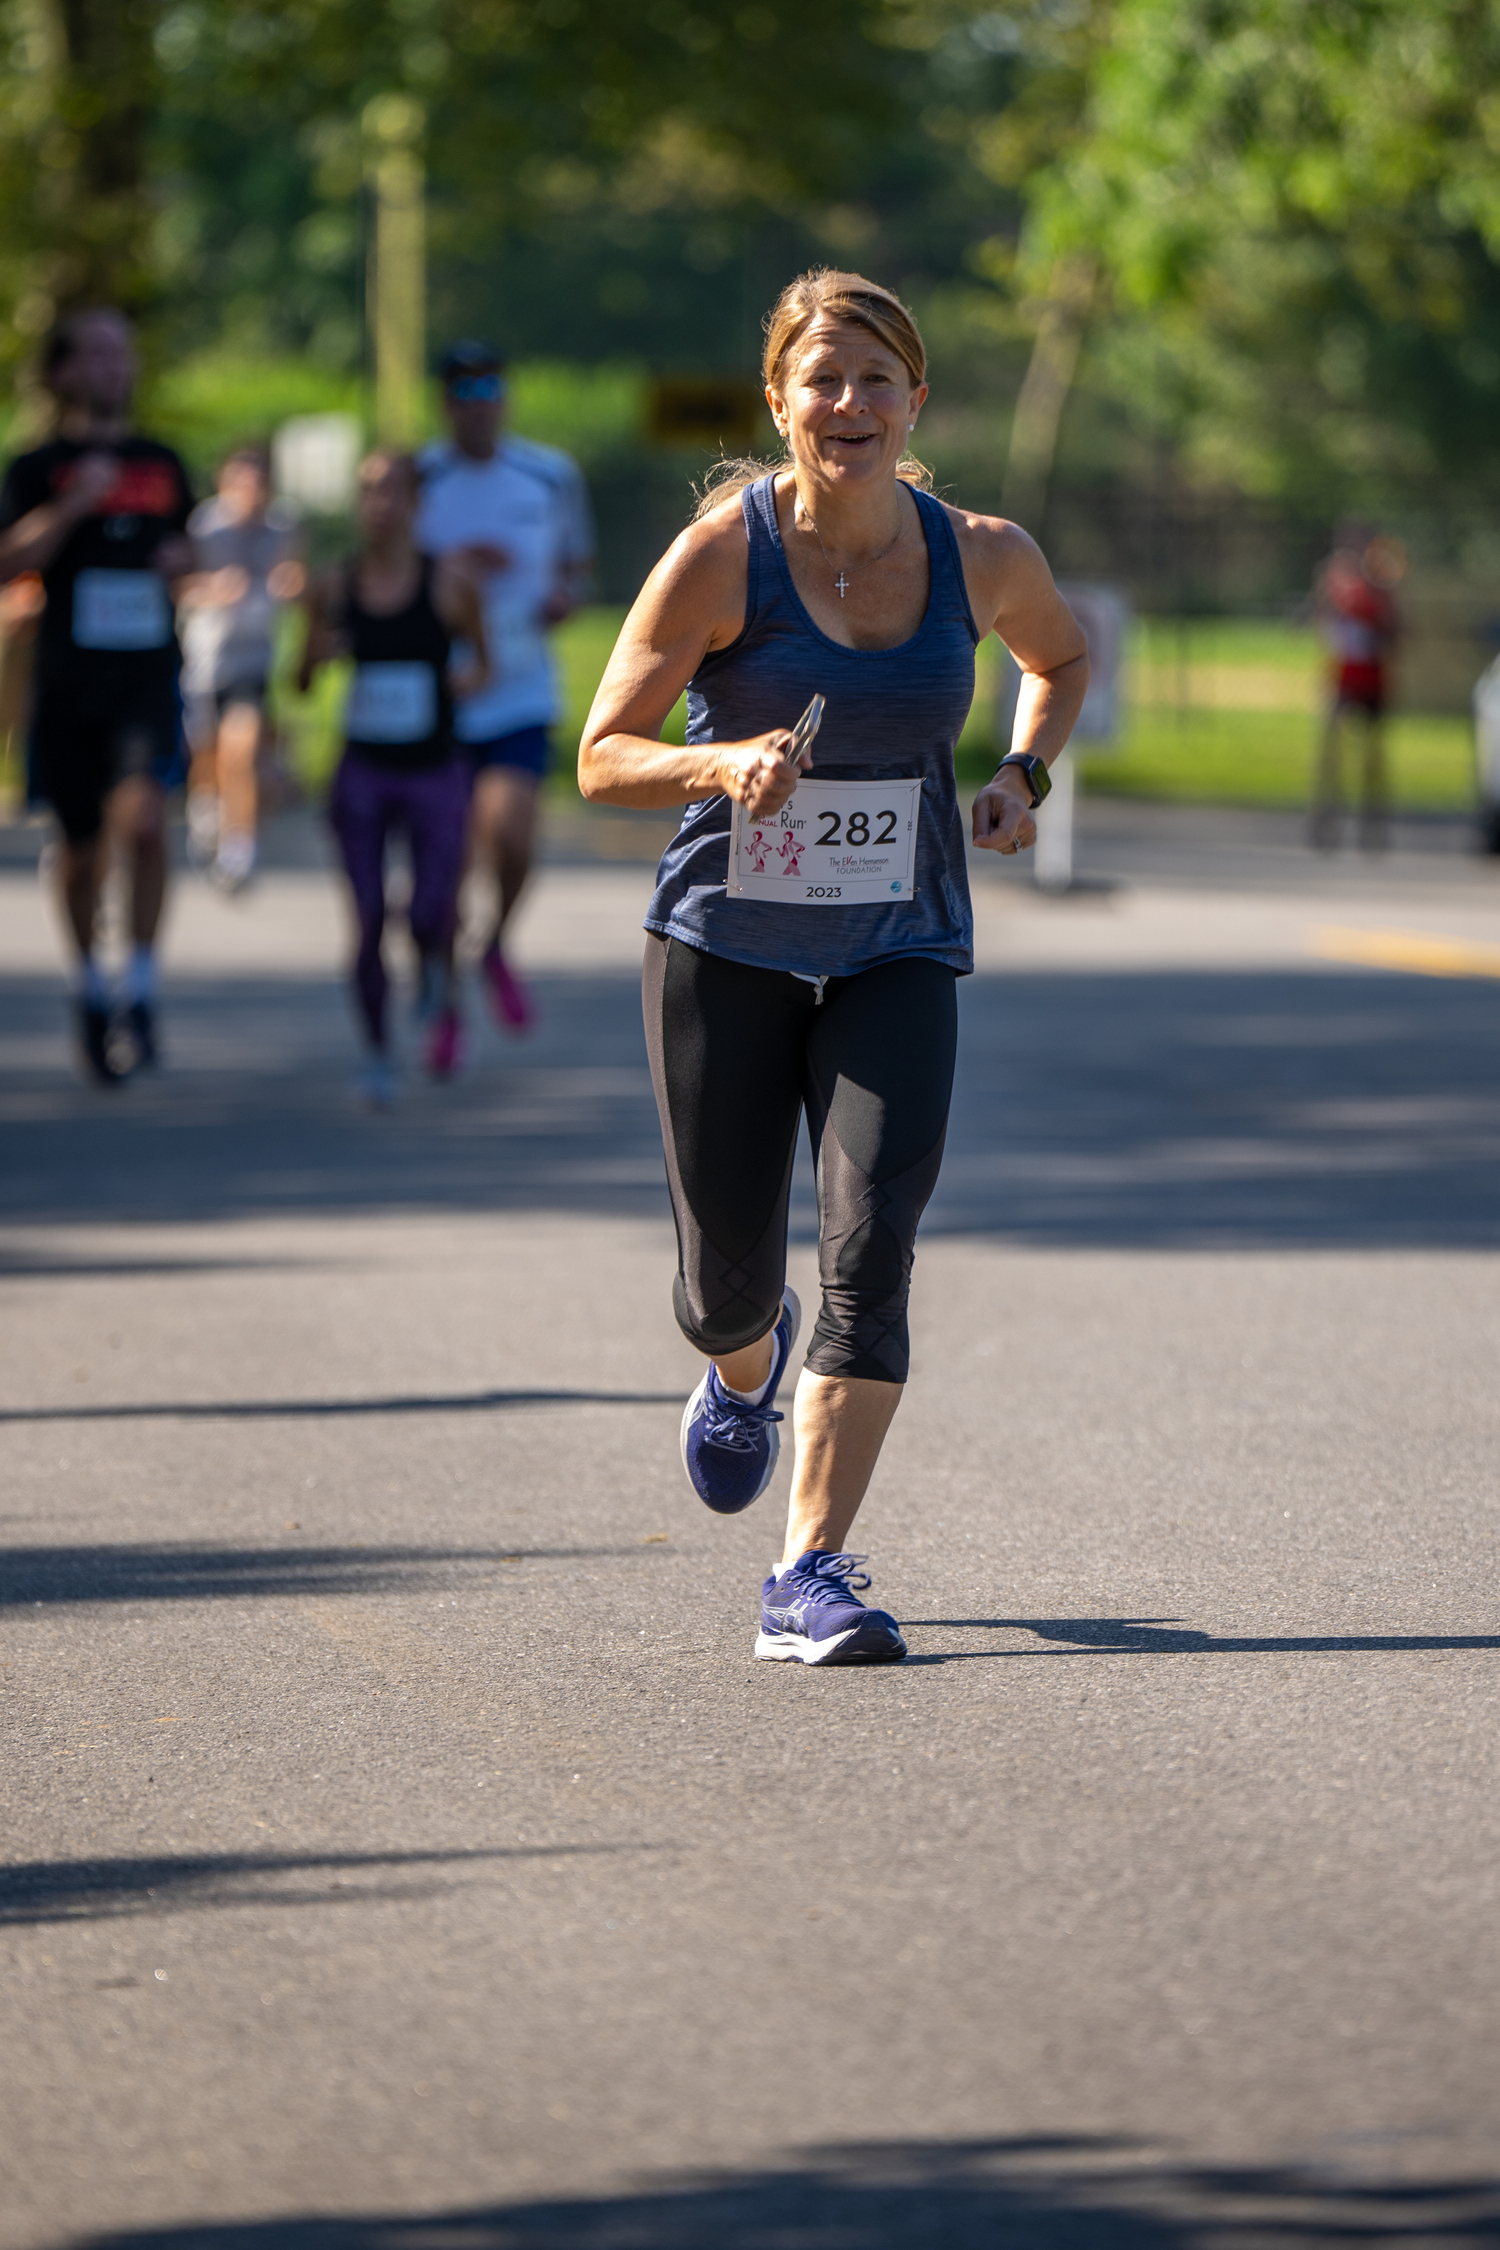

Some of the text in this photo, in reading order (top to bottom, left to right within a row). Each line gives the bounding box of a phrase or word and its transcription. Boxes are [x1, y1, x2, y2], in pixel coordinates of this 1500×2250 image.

[780, 811, 804, 829] Run
[813, 810, 897, 847] 282
[829, 857, 841, 866] The
[836, 866, 882, 874] FOUNDATION
[805, 886, 842, 898] 2023
